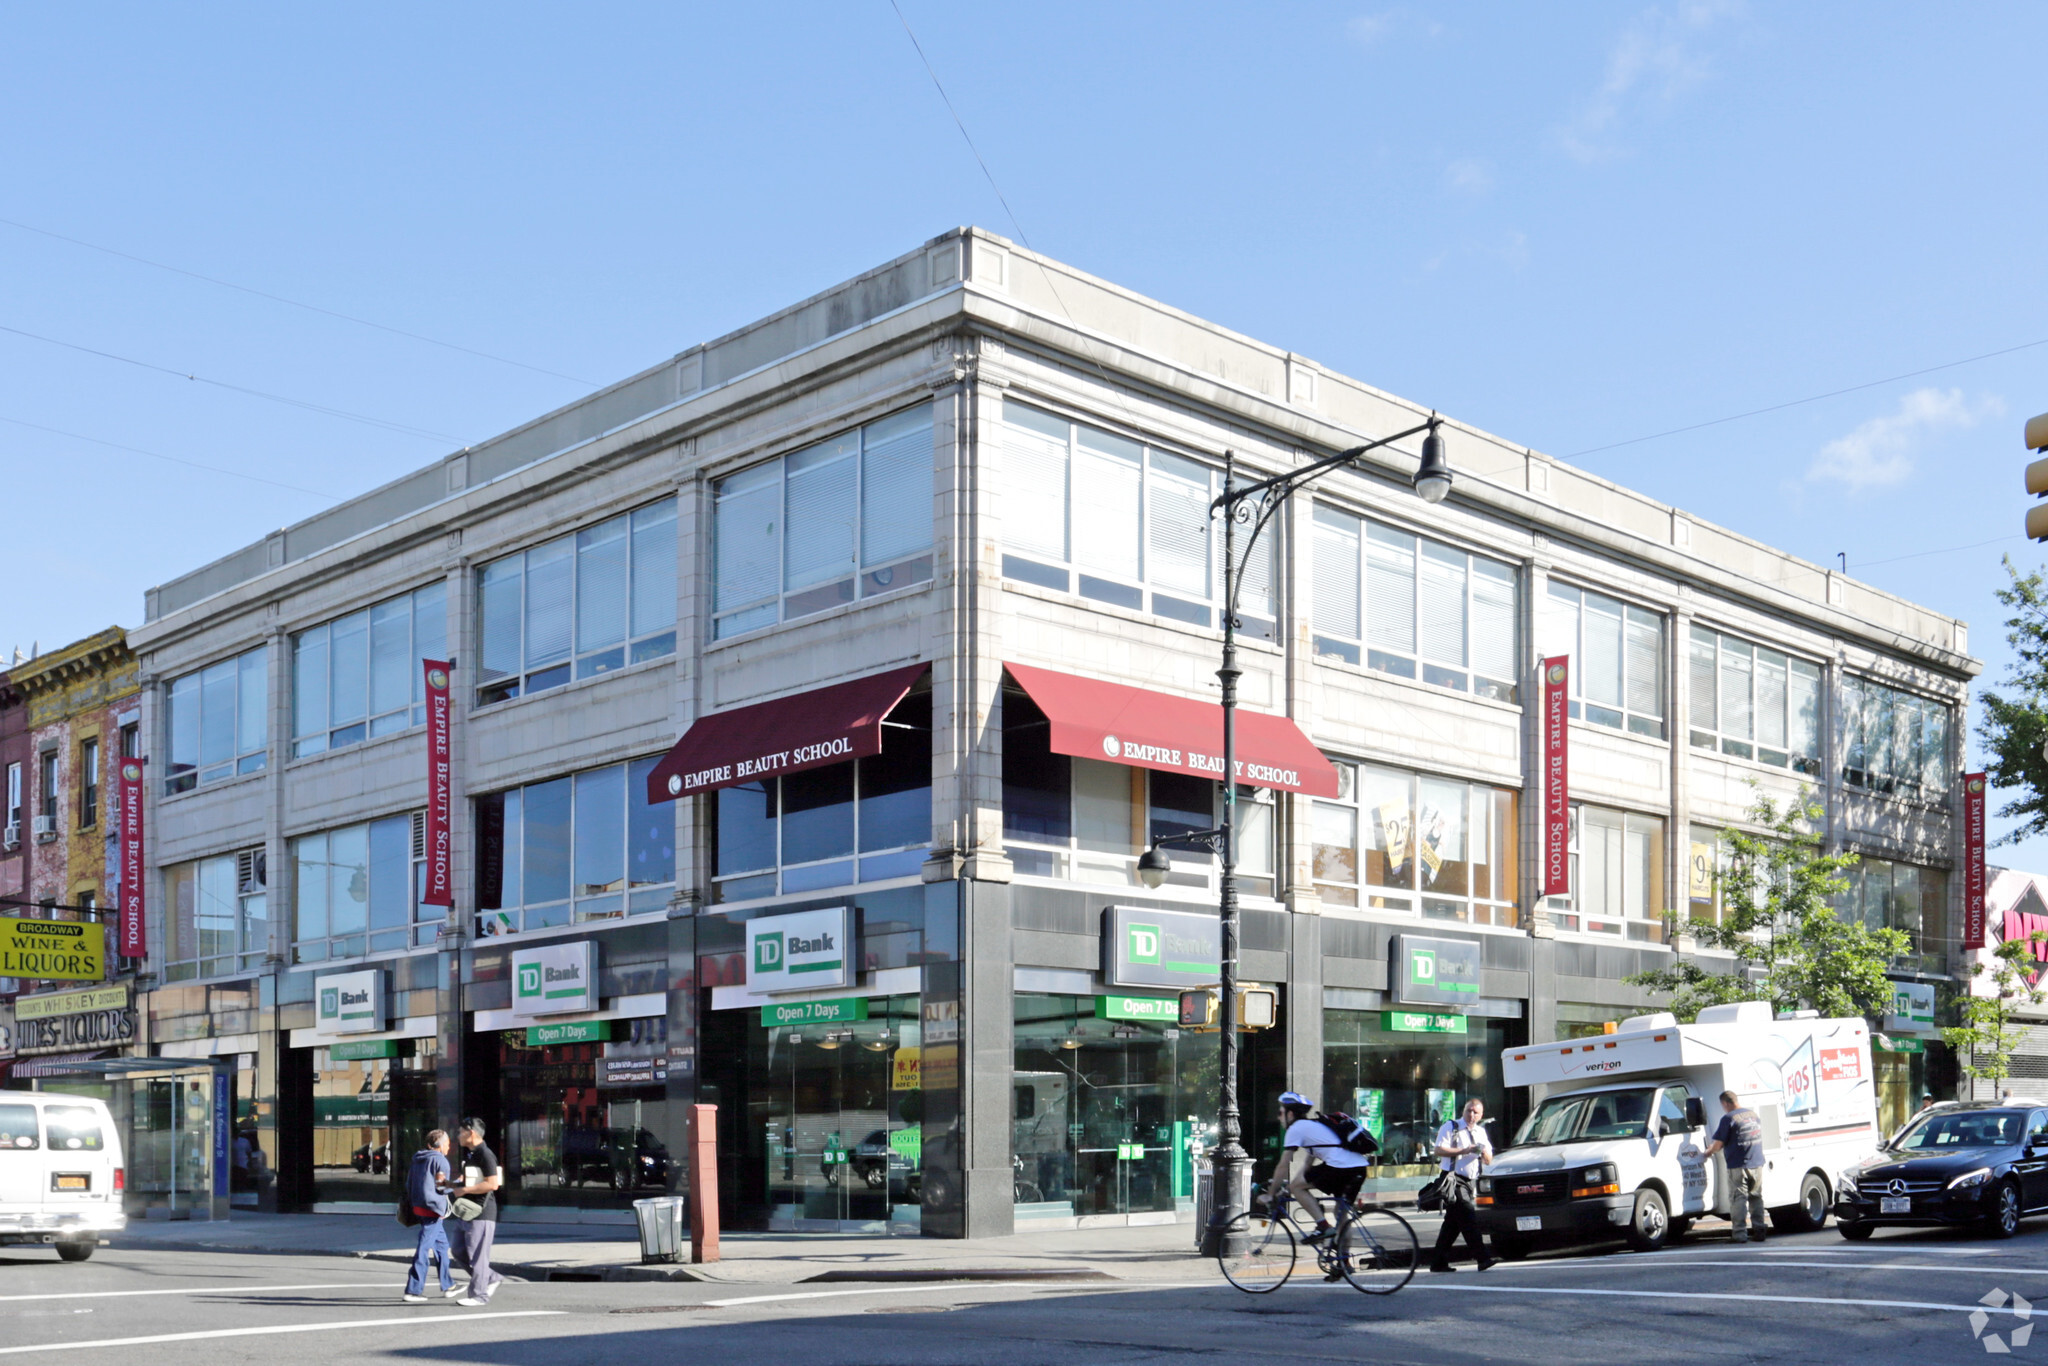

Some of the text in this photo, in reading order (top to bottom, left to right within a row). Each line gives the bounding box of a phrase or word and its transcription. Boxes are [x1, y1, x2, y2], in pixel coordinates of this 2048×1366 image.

[684, 737, 852, 789] EMPIRE BEAUTY SCHOOL
[1123, 741, 1301, 786] EMPIRE BEAUY SCHOOL
[433, 694, 448, 895] EMPIRE BEAUTY SCHOOL
[1551, 690, 1564, 885] EMPIRE BEAUTY SCHOOL
[127, 786, 140, 949] EMPIRE BEAUTY SCHOOL
[1971, 798, 1982, 942] EMPIRE BEAUTY SCHOOL
[19, 924, 81, 936] BROADWAY
[11, 936, 89, 952] WINE &
[757, 932, 835, 965] TD Bank
[1131, 930, 1157, 957] TD
[4, 951, 96, 975] LIQUORS
[1413, 955, 1434, 979] TD
[519, 963, 580, 992] TD Bank
[43, 993, 97, 1013] WHISKEY
[322, 989, 369, 1014] TD Bank
[776, 1003, 840, 1022] Open 7 Days
[1123, 998, 1179, 1016] Open 7 Da
[538, 1025, 587, 1042] Open 7 Days
[1404, 1014, 1455, 1031] Open 7 Days
[339, 1044, 377, 1057] Open 7 Days
[1585, 1060, 1622, 1072] verizon
[1787, 1064, 1810, 1097] FiOS
[216, 1076, 224, 1111] Broadway
[823, 1152, 833, 1162] TD
[836, 1151, 847, 1162] TD
[1517, 1184, 1544, 1194] GMC
